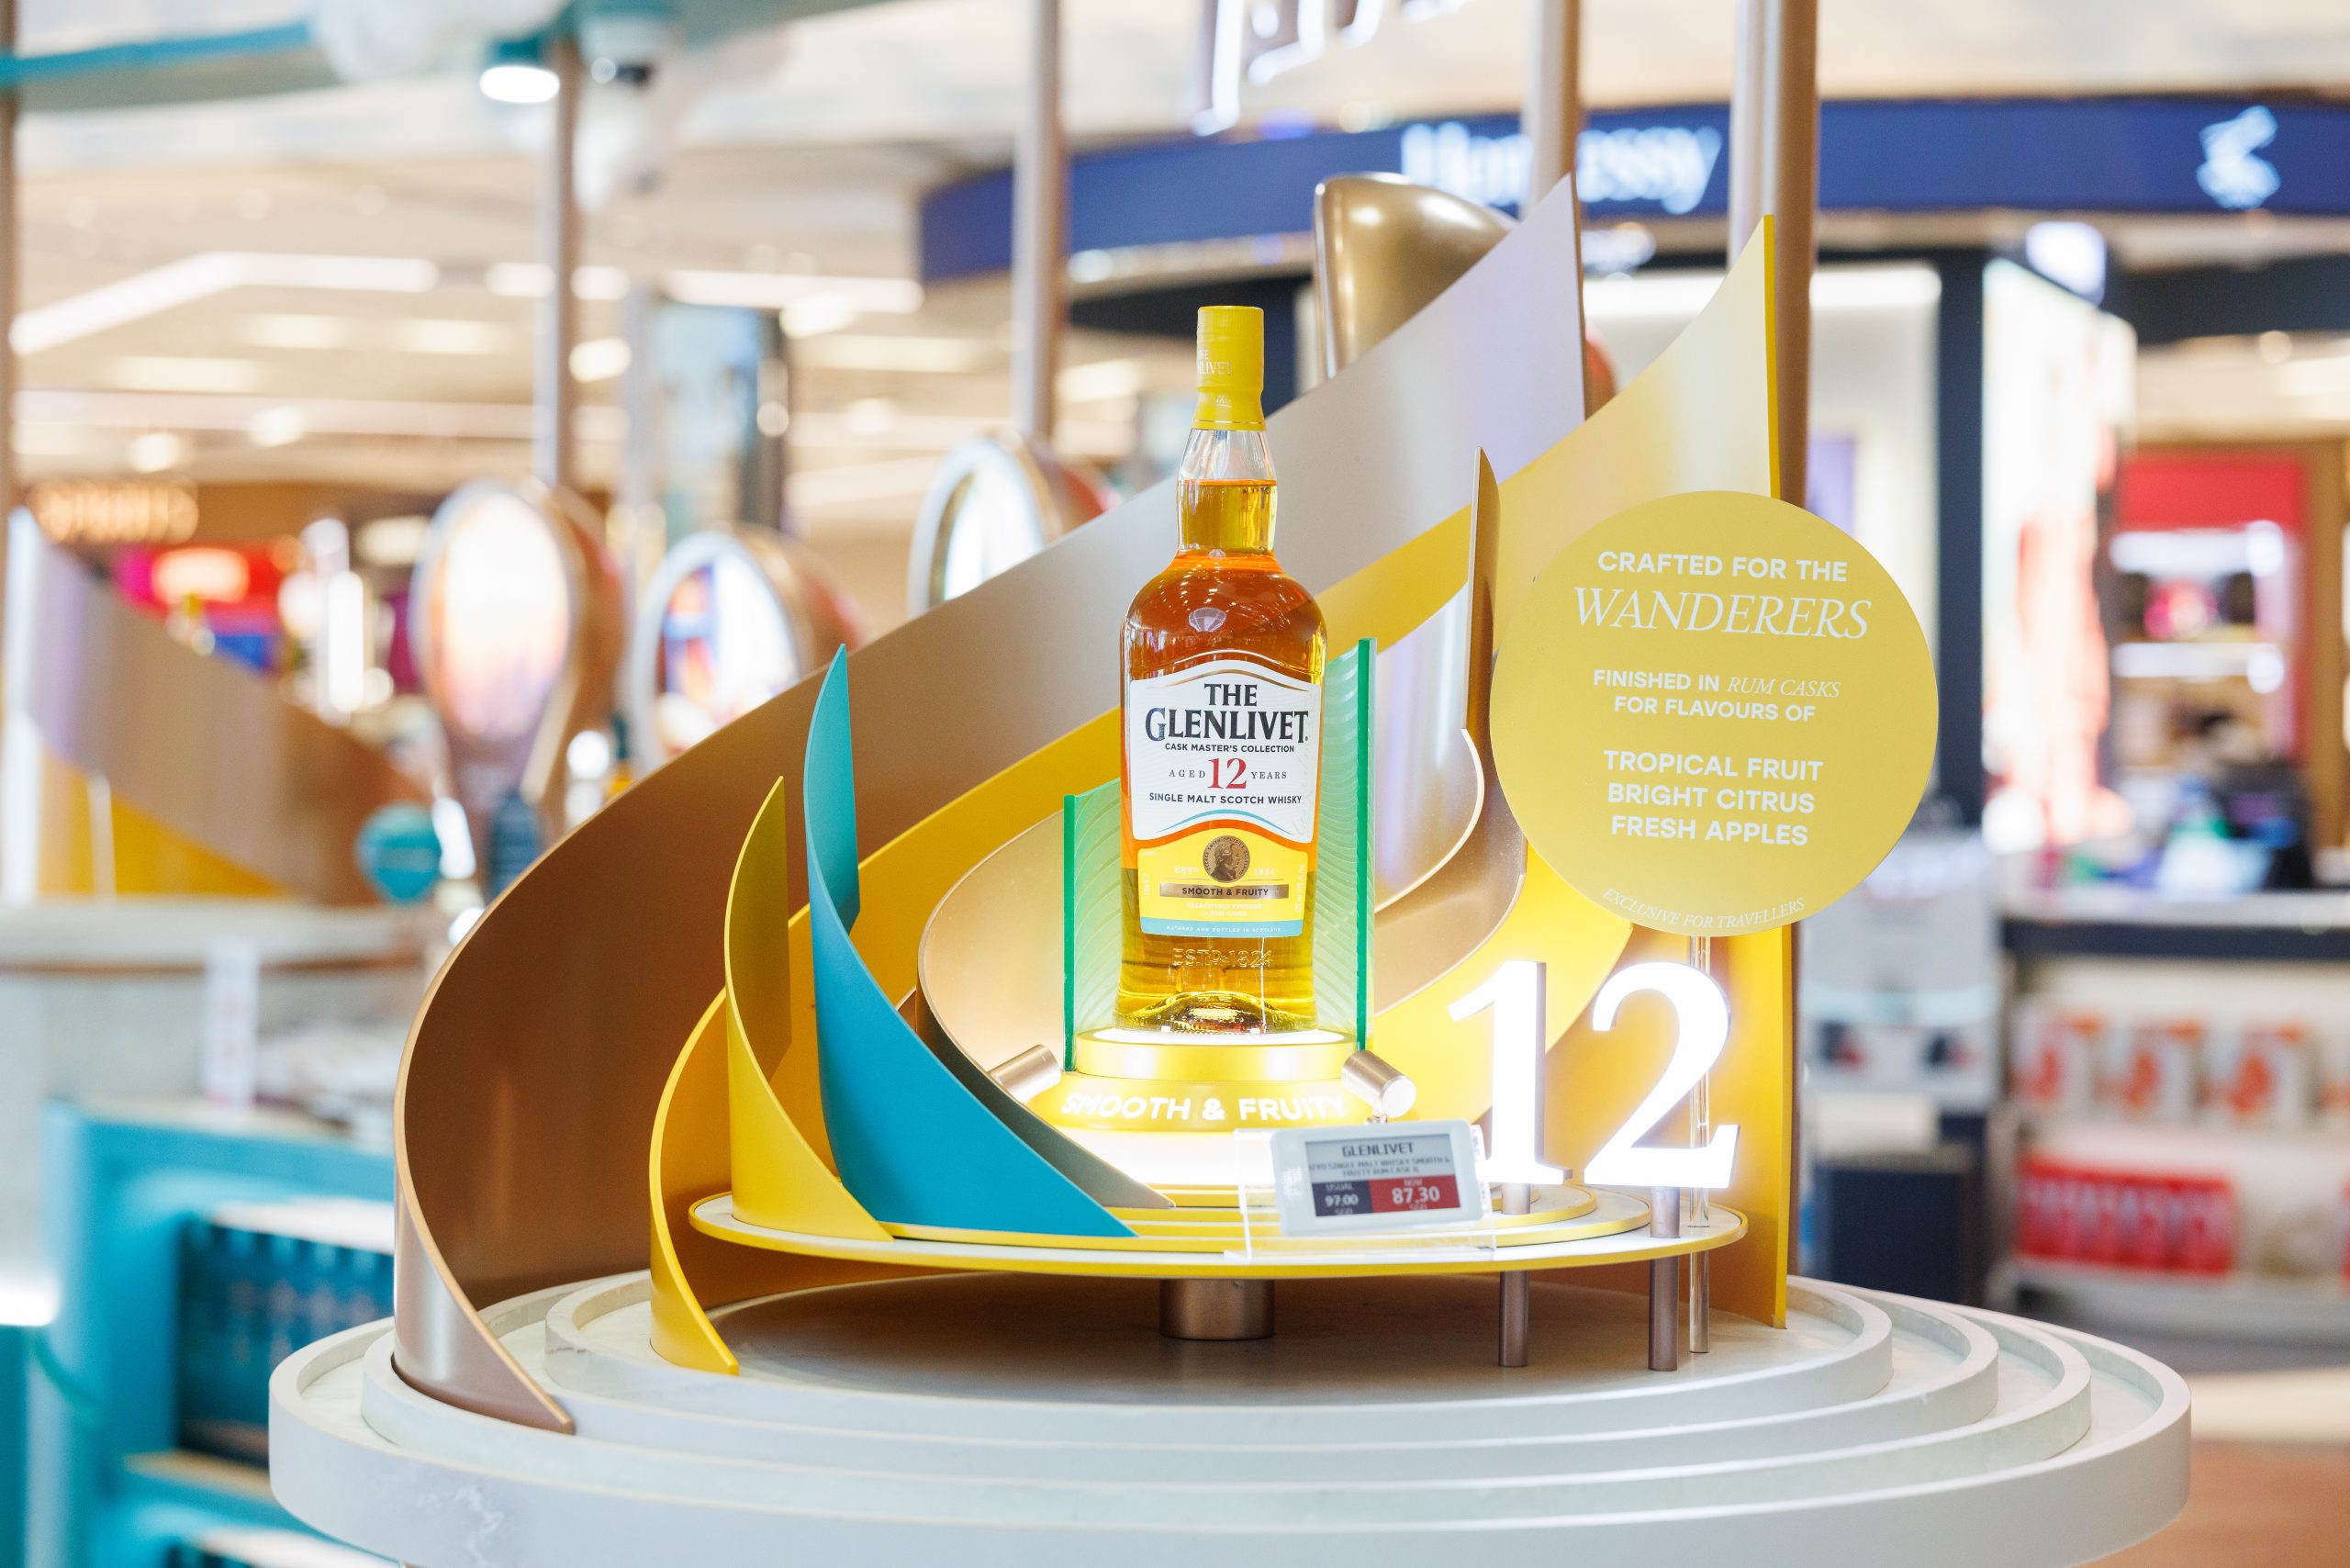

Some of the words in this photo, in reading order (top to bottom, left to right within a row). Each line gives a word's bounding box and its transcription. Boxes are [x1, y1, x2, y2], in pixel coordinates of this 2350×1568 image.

[1598, 550, 1723, 577] CRAFTED
[1732, 557, 1786, 580] FOR
[1796, 560, 1848, 582] THE
[1573, 586, 1872, 641] WANDERERS
[1203, 683, 1258, 707] THE
[1594, 669, 1691, 690] FINISHED
[1698, 675, 1720, 692] IN
[1727, 676, 1775, 695] RUM
[1780, 679, 1841, 699] CASKS
[1614, 696, 1658, 715] FOR
[1664, 699, 1778, 721] FLAVOURS
[1785, 704, 1816, 722] OF
[1145, 707, 1309, 744] GLENLIVET
[1165, 743, 1188, 751] CASK
[1191, 744, 1238, 753] MASTER'S
[1241, 745, 1294, 753] COLLECTION
[1169, 769, 1205, 778] AGED
[1207, 757, 1247, 790] 12
[1251, 771, 1287, 779] YEARS
[1604, 750, 1738, 777] TROPICAL
[1747, 757, 1824, 781] FRUIT
[1149, 792, 1183, 802] SINGLE
[1187, 795, 1216, 804] MALT
[1220, 796, 1264, 805] SCOTCH
[1268, 795, 1302, 804] WHISKY
[1607, 783, 1707, 808] BRIGHT
[1717, 790, 1815, 814] CITRUS
[1611, 815, 1695, 840] FRESH
[1705, 821, 1808, 846] APPLES
[1181, 887, 1223, 896] SMOOTH
[1226, 888, 1233, 896] &
[1236, 888, 1269, 896] FRUITY
[1602, 888, 1682, 924] EXCLUSIVE
[1684, 914, 1713, 928] FOR
[1718, 897, 1806, 929] TRAVELLERS
[1446, 958, 1740, 1189] 12
[1060, 1092, 1191, 1120] SMOOTH
[1202, 1098, 1225, 1120] &
[1238, 1096, 1348, 1120] FRUITY
[1342, 1141, 1415, 1158] GLENLIVET
[1325, 1194, 1360, 1207] 97.00
[1392, 1186, 1439, 1205] 87.30
